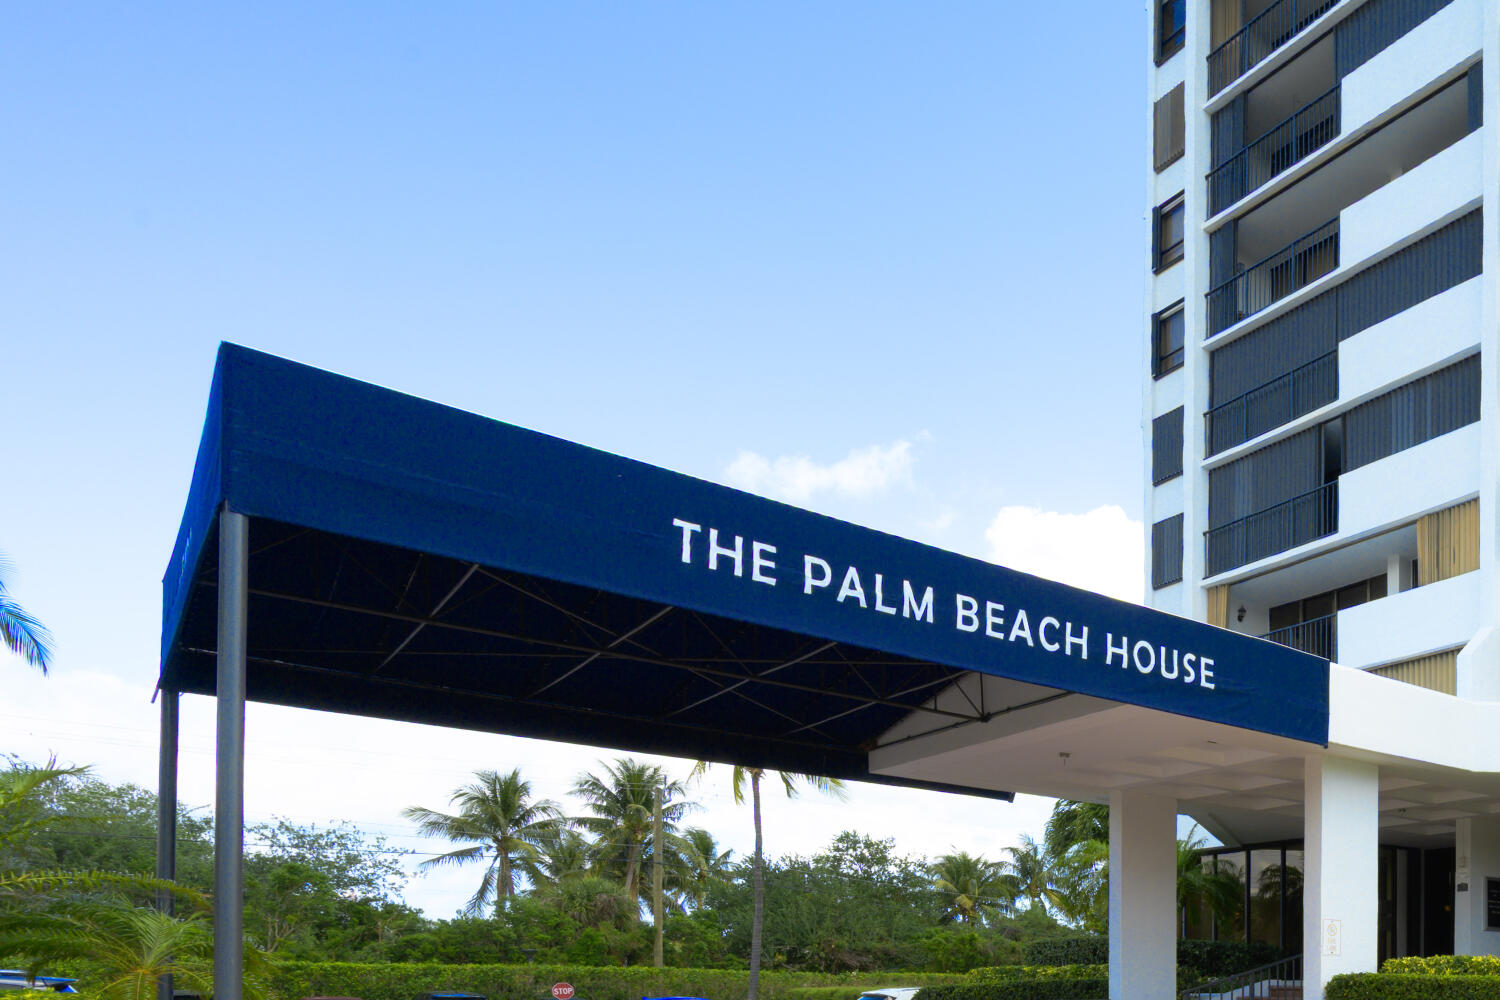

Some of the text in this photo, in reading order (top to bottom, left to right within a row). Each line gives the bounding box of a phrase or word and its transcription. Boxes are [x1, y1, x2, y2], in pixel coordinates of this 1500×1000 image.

[672, 518, 1216, 690] THE PALM BEACH HOUSE
[554, 987, 573, 996] STOP
